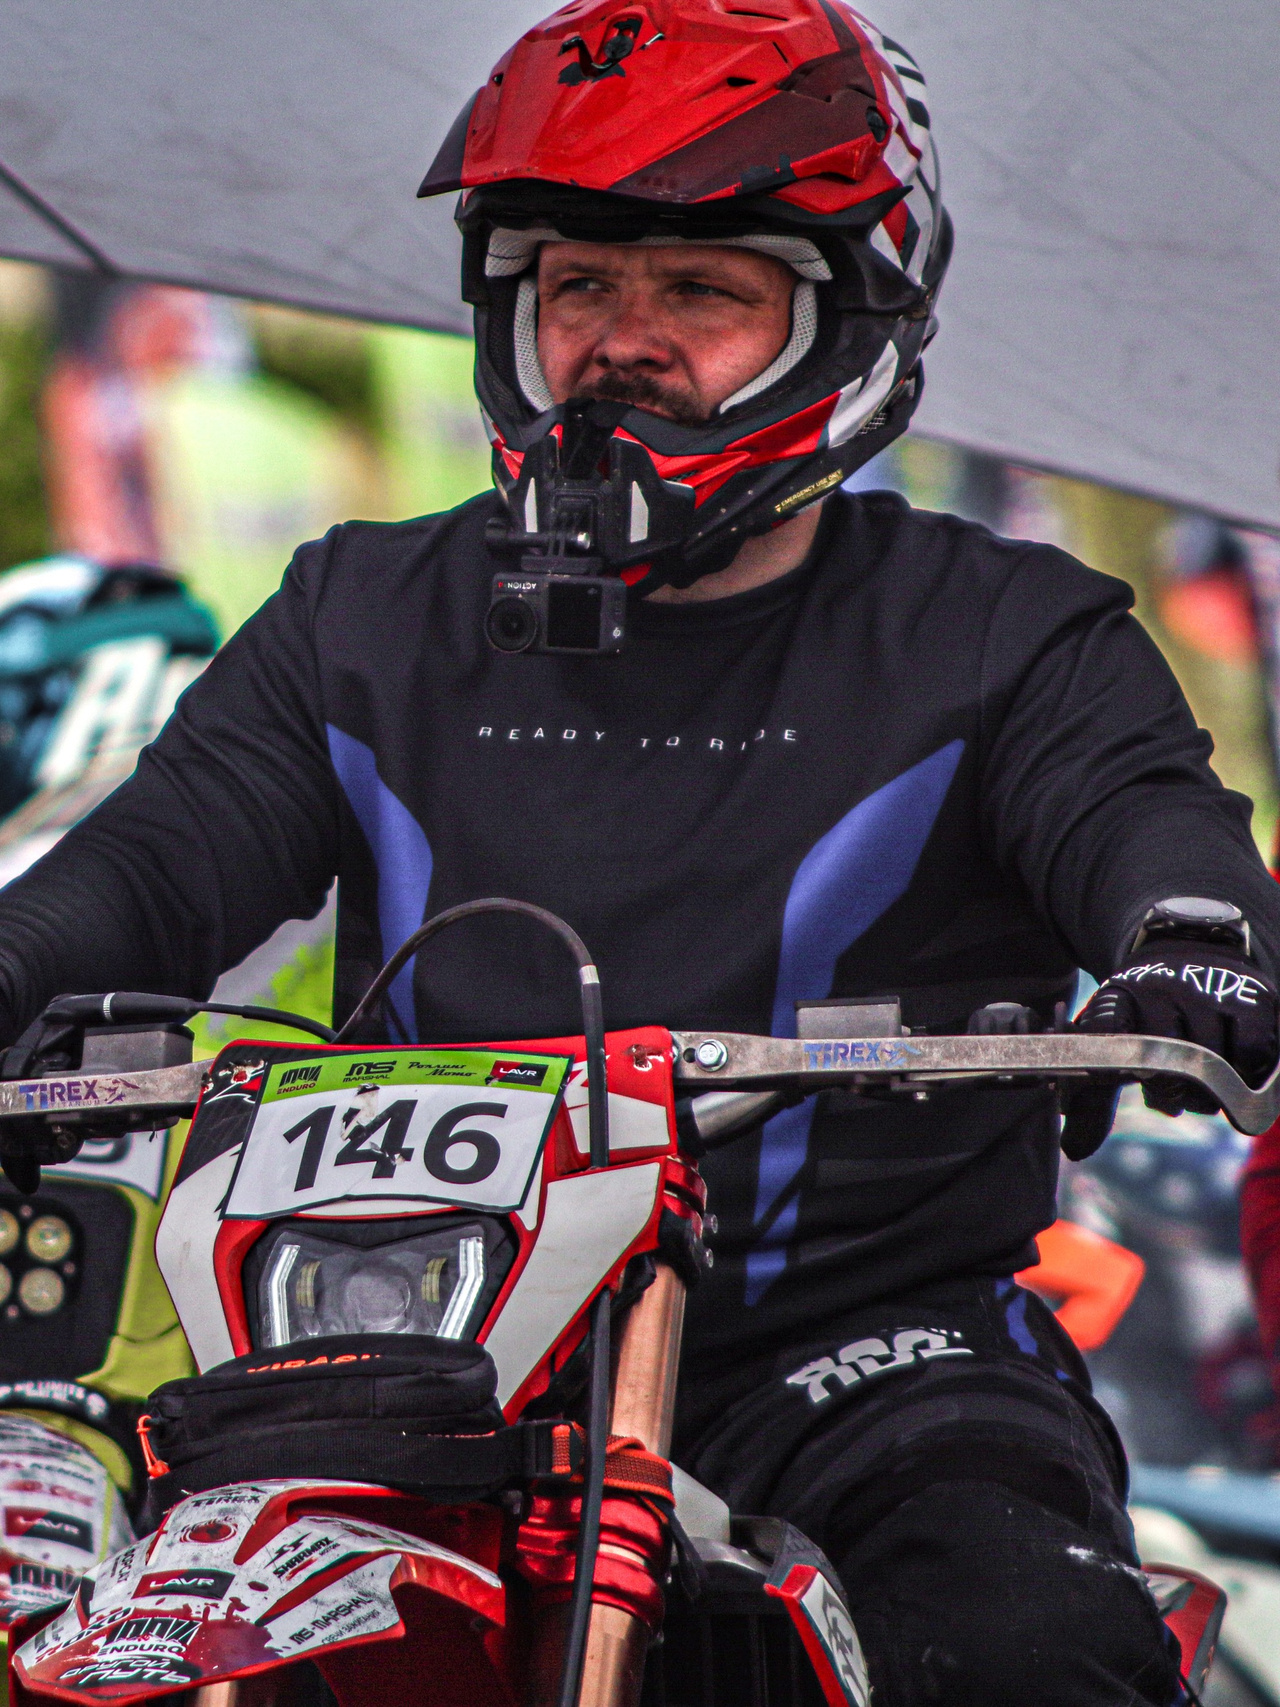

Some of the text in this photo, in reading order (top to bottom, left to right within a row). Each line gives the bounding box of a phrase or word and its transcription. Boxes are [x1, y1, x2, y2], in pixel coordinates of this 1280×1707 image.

[781, 484, 815, 506] EMERGENCY
[507, 581, 537, 590] ACTION
[478, 726, 605, 740] READY
[640, 736, 680, 748] TO
[1182, 964, 1269, 1004] RIDE
[342, 1074, 390, 1083] MARSHAL
[499, 1067, 537, 1077] LAVR
[277, 1082, 316, 1095] ENDURO
[282, 1098, 509, 1192] 146
[17, 1515, 79, 1534] LAVR
[272, 1537, 334, 1578] SHARMAX
[149, 1577, 215, 1588] LAVR
[98, 1643, 183, 1656] ENDURO
